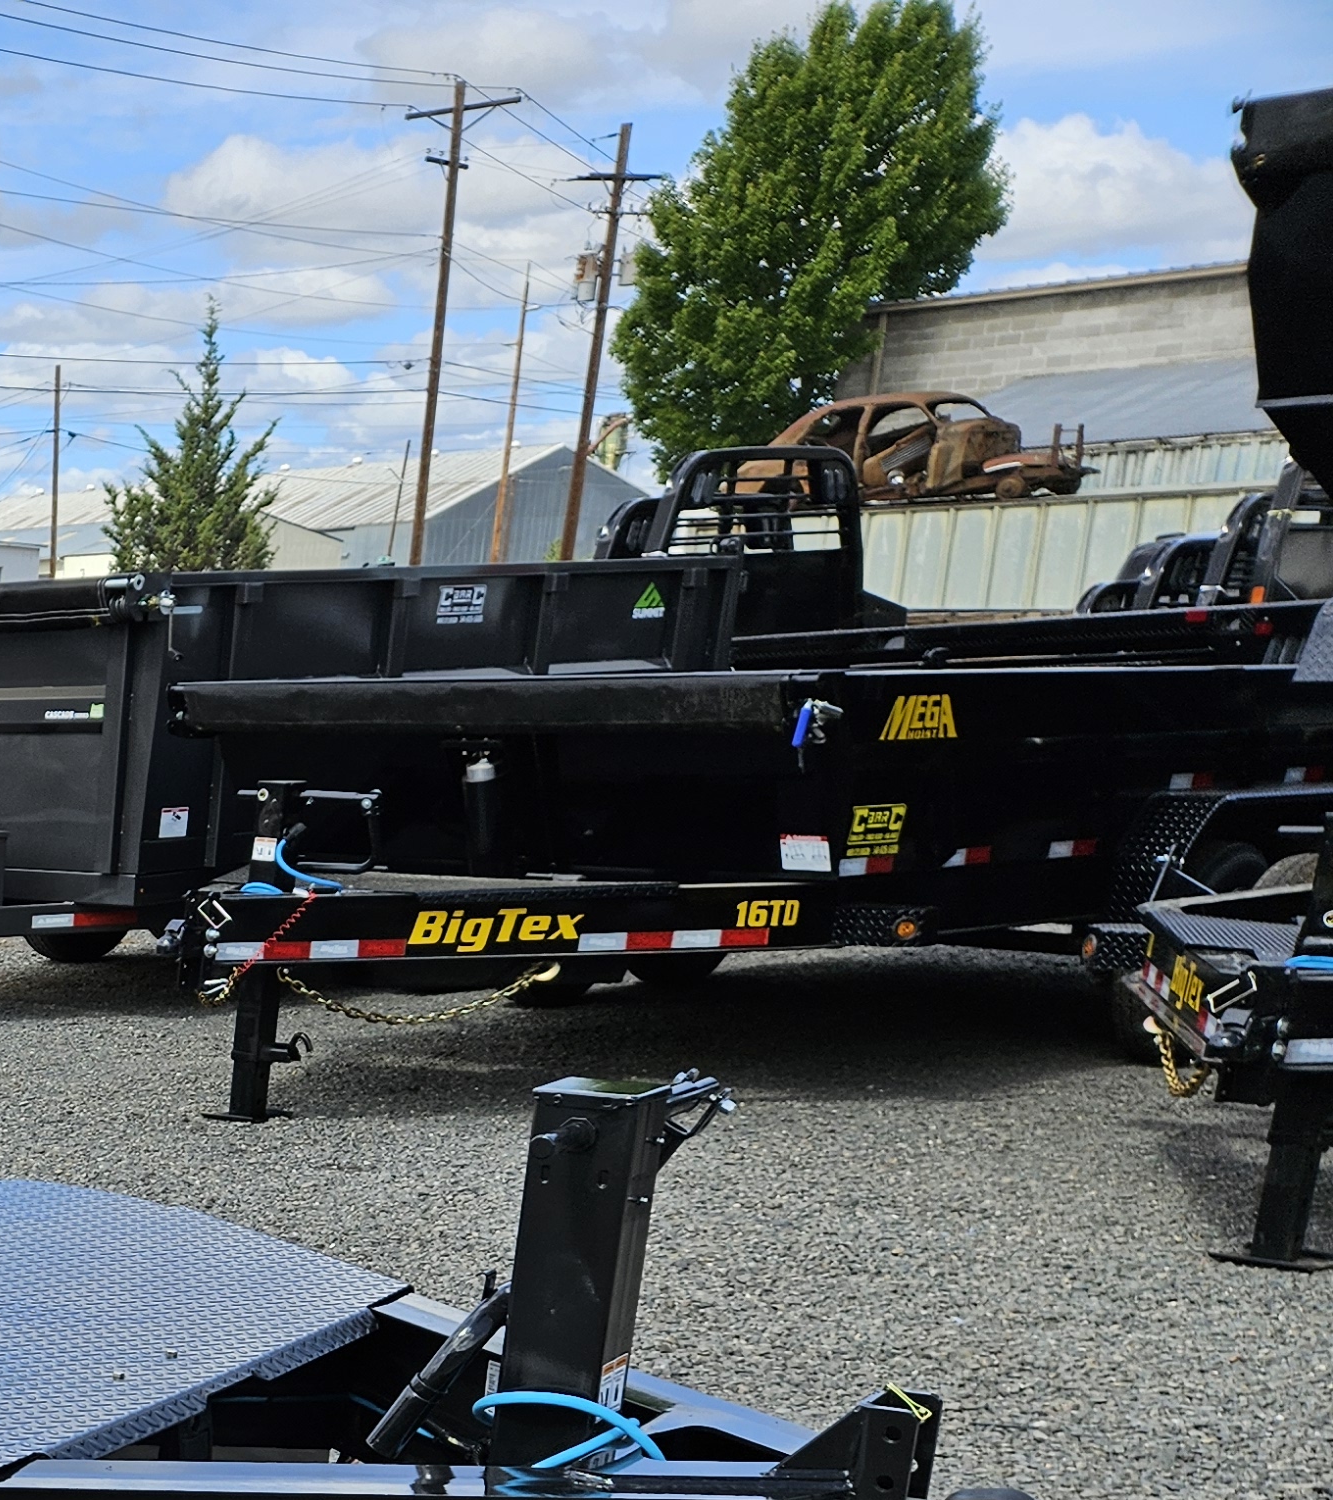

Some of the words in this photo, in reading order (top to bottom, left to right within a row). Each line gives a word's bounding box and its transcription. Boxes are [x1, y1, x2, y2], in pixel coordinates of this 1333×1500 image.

[878, 694, 958, 740] MEGA
[907, 729, 938, 739] HOIST
[853, 808, 869, 832] C
[888, 807, 905, 830] C
[407, 908, 584, 952] BigTex
[736, 900, 800, 927] 16TD
[1170, 955, 1204, 1012] BigTex
